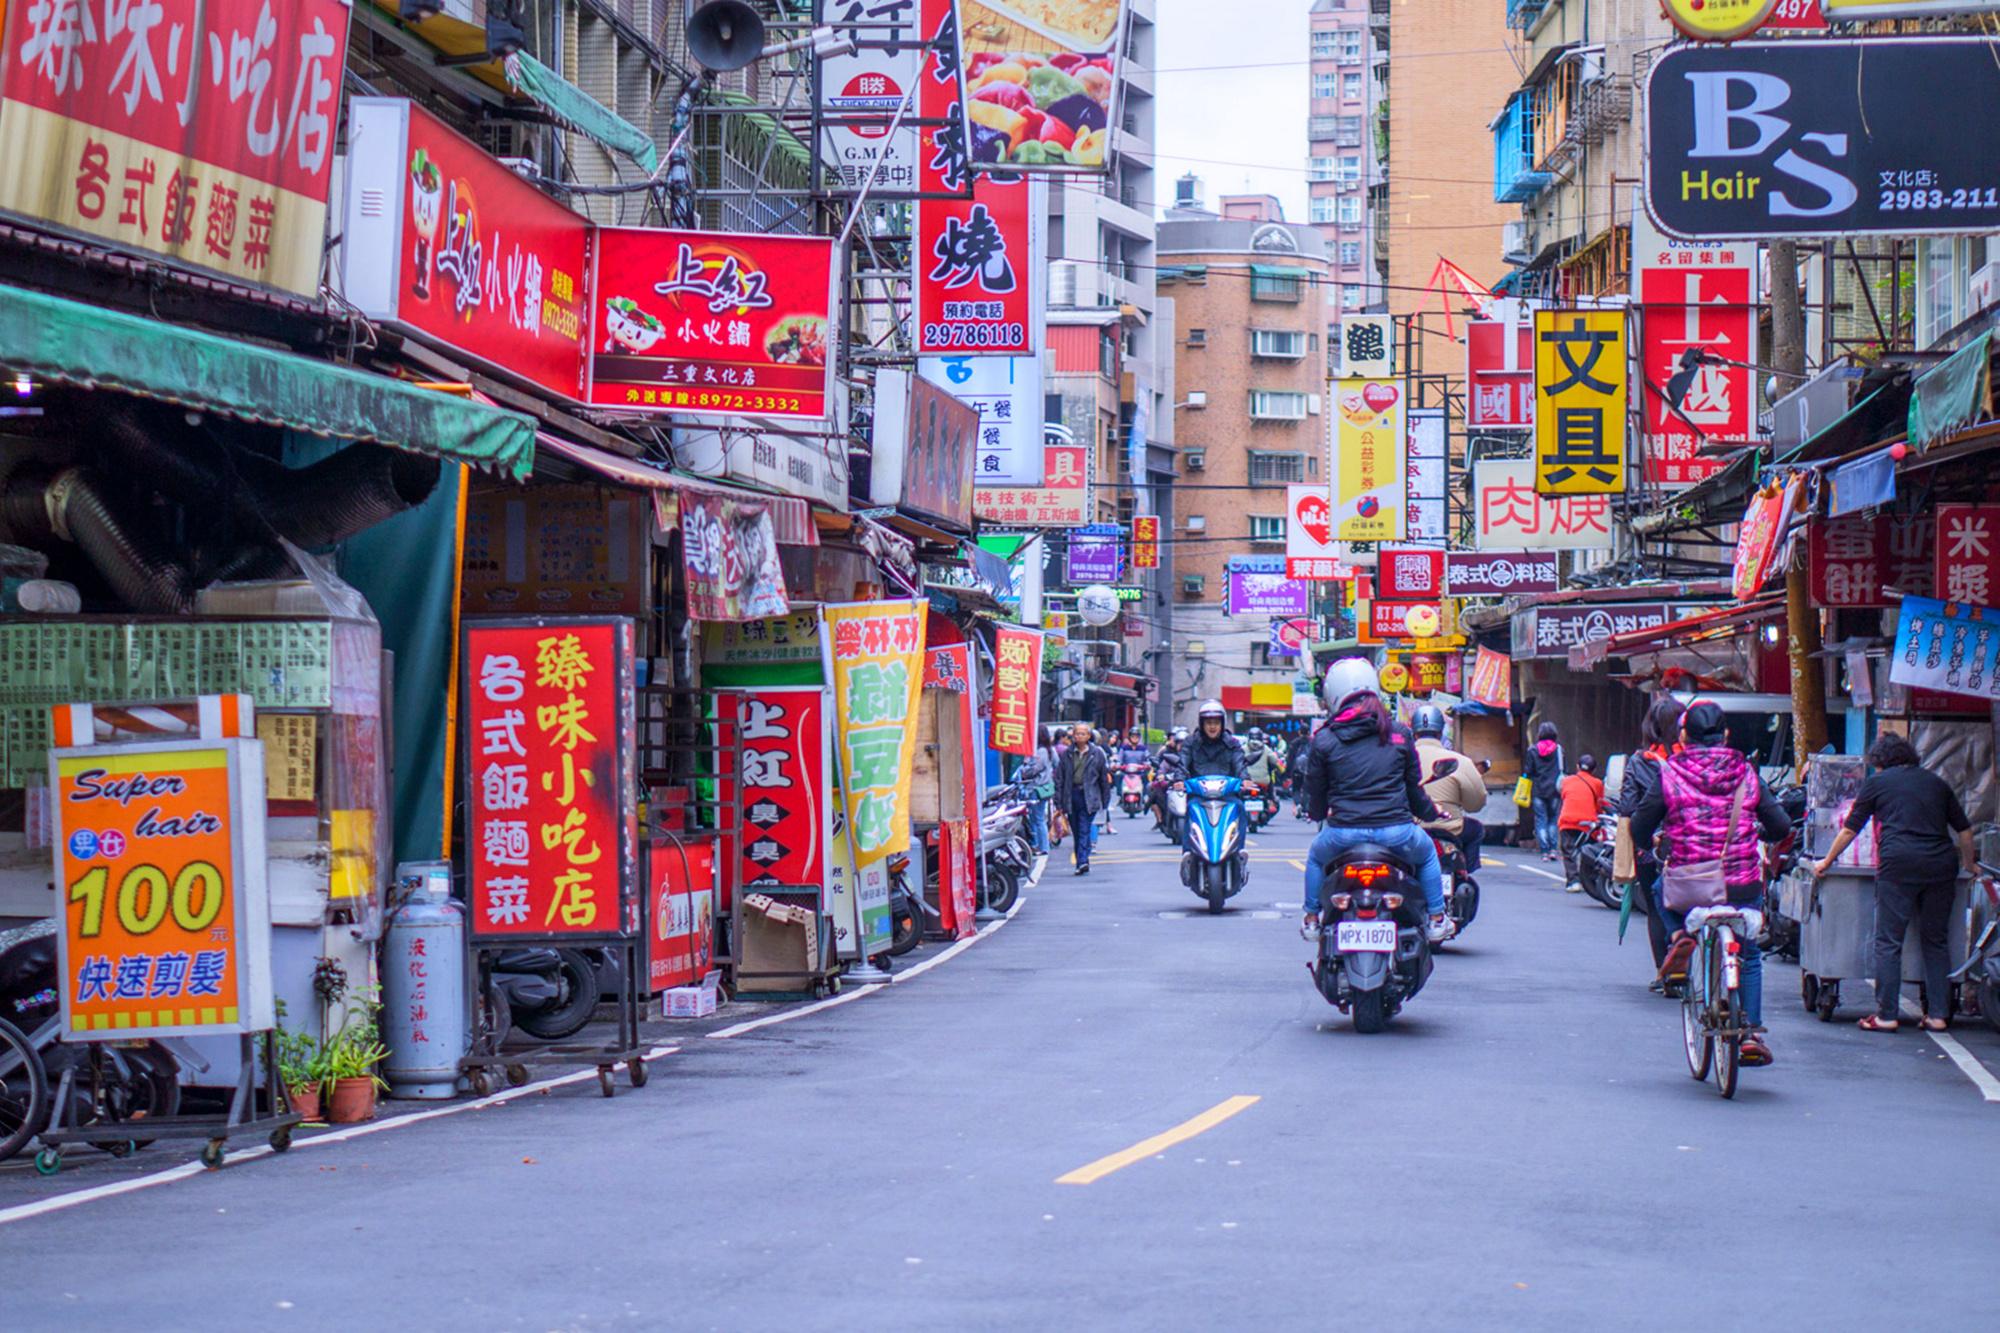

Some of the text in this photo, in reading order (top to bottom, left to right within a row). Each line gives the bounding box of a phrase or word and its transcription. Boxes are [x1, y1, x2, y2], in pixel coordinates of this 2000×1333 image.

[1680, 170, 1761, 202] Hair
[654, 242, 774, 314] 上紅
[943, 301, 1004, 320] 預約電話
[677, 318, 752, 348] 小火鍋
[924, 322, 1025, 347] 29786118
[661, 363, 757, 387] 三重文化店
[1539, 317, 1621, 487] 文具
[1448, 563, 1489, 585] 泰式
[1946, 515, 1991, 607] 米漿
[1537, 614, 1585, 648] 泰式
[69, 767, 188, 806] Super
[479, 653, 532, 926] 各式飯麵菜
[534, 632, 602, 929] 臻味小吃店
[134, 807, 222, 838] hair
[1339, 928, 1394, 945] MPX-1870
[75, 949, 228, 1002] 快速剪髮
